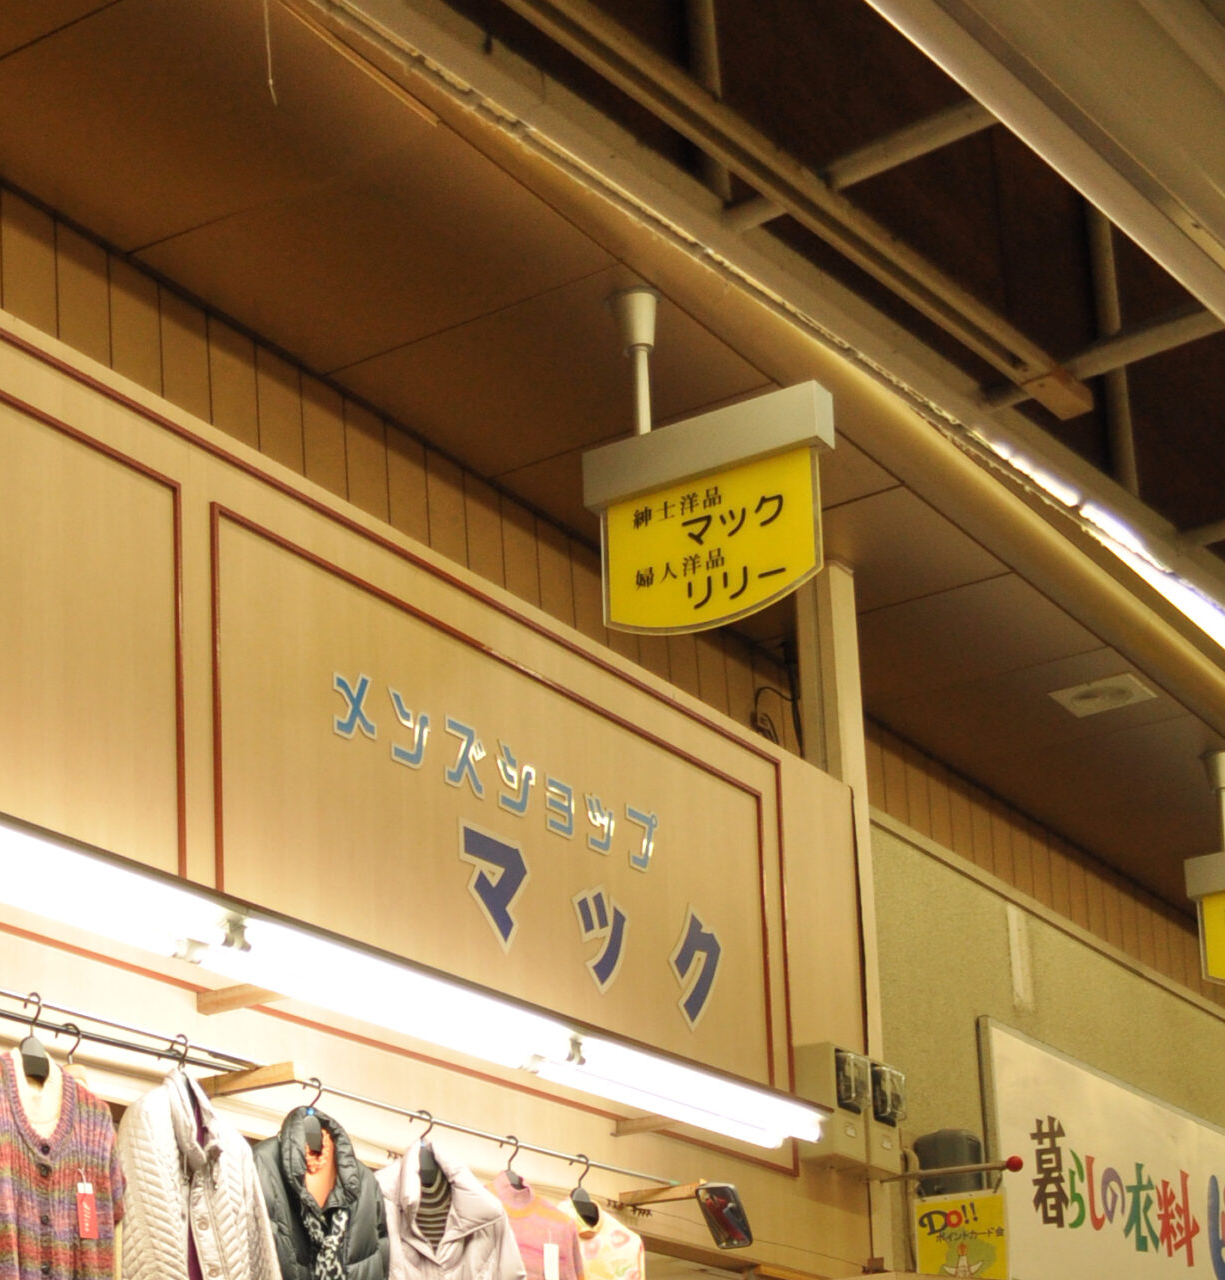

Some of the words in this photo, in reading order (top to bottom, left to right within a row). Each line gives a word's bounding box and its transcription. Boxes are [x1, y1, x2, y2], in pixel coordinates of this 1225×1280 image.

[632, 486, 722, 531] 紳士洋品
[681, 493, 784, 545] マック
[635, 547, 725, 590] 婦人洋品
[686, 566, 786, 610] リリー
[333, 672, 660, 872] メンズショップ
[459, 816, 722, 1031] マック
[1030, 1115, 1200, 1268] 暮らしの衣料
